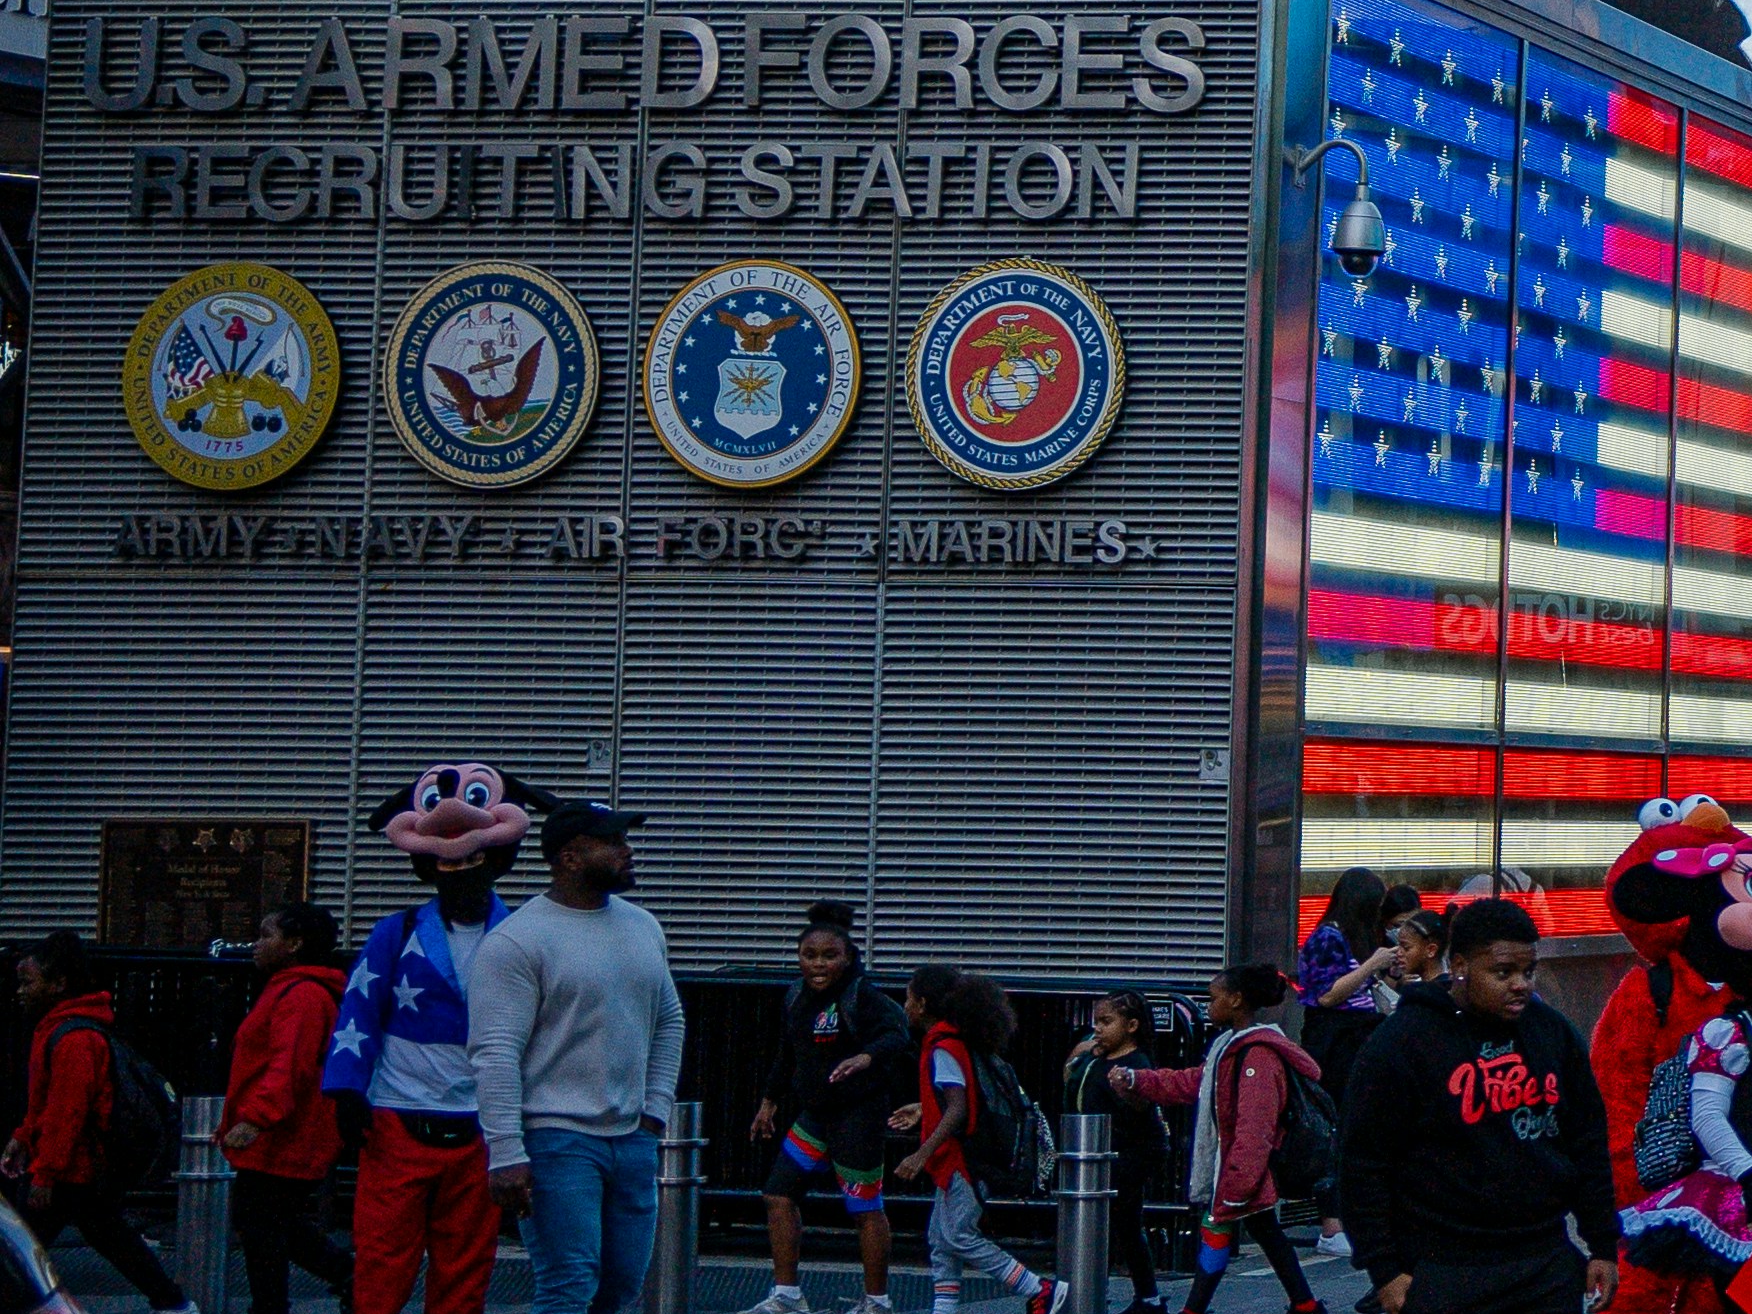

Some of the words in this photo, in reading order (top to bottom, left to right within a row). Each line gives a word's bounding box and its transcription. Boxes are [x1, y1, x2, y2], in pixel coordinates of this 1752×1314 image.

[81, 16, 267, 112] U.S.
[288, 15, 720, 112] ARMED
[743, 13, 1208, 113] FORCES
[129, 143, 707, 222] RECRUITING
[735, 142, 1142, 220] STATION
[730, 269, 758, 287] OF
[771, 271, 812, 300] THE
[137, 273, 237, 357] DEPARTMENT
[247, 274, 270, 288] OF
[277, 281, 309, 315] THE
[307, 321, 333, 372] ARMY
[404, 284, 485, 369] DEPARTMENT
[491, 283, 514, 297] OF
[521, 288, 551, 315] THE
[548, 312, 578, 355] NAVY
[652, 280, 718, 404] DEPARTMENT
[814, 302, 842, 337] AIR
[926, 280, 1017, 375] DEPARTMENT
[1020, 282, 1039, 296] OF
[1042, 288, 1071, 311] THE
[1069, 307, 1103, 359] NAVY
[826, 348, 851, 419] FORCE
[205, 440, 244, 453] 1775
[714, 438, 776, 455] MCMXLVII
[929, 393, 967, 447] UNITED
[967, 443, 1018, 466] STATES
[1024, 426, 1079, 464] MARINE
[1076, 379, 1102, 427] CORPS
[111, 515, 267, 558] ARMY
[315, 515, 475, 558] NAVY
[543, 515, 626, 558] AIR
[898, 519, 1127, 563] MARINES
[1479, 1039, 1514, 1060] Good
[1447, 1053, 1559, 1125] Vibes
